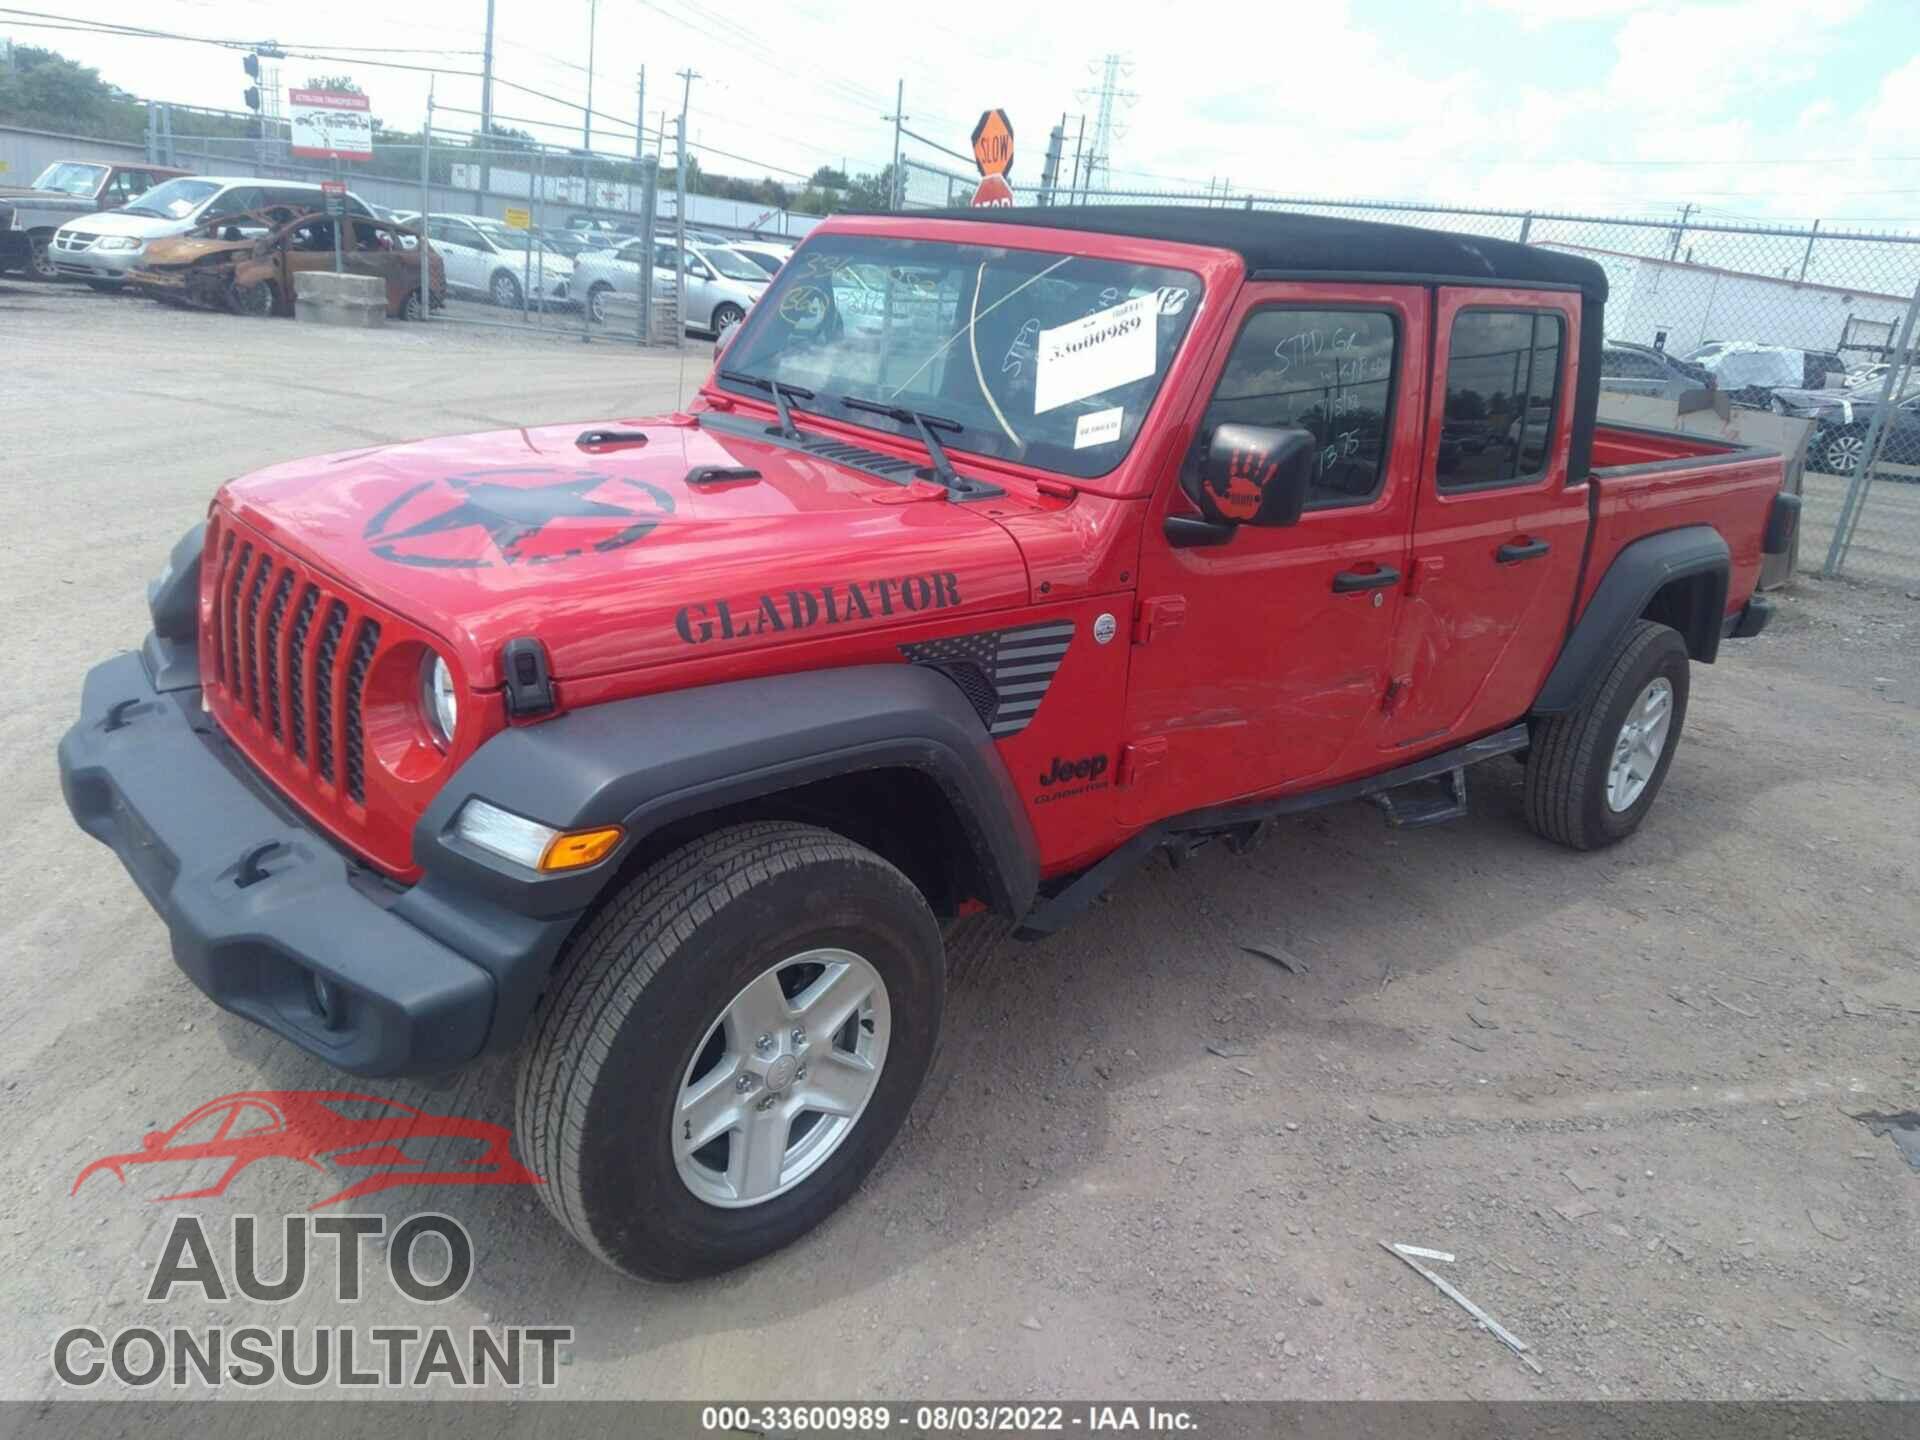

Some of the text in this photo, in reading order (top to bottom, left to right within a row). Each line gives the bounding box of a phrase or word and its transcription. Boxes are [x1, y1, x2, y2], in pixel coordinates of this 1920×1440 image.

[980, 134, 1009, 164] SLOW
[675, 570, 963, 645] GLADIATOR
[1039, 753, 1109, 786] Jeep
